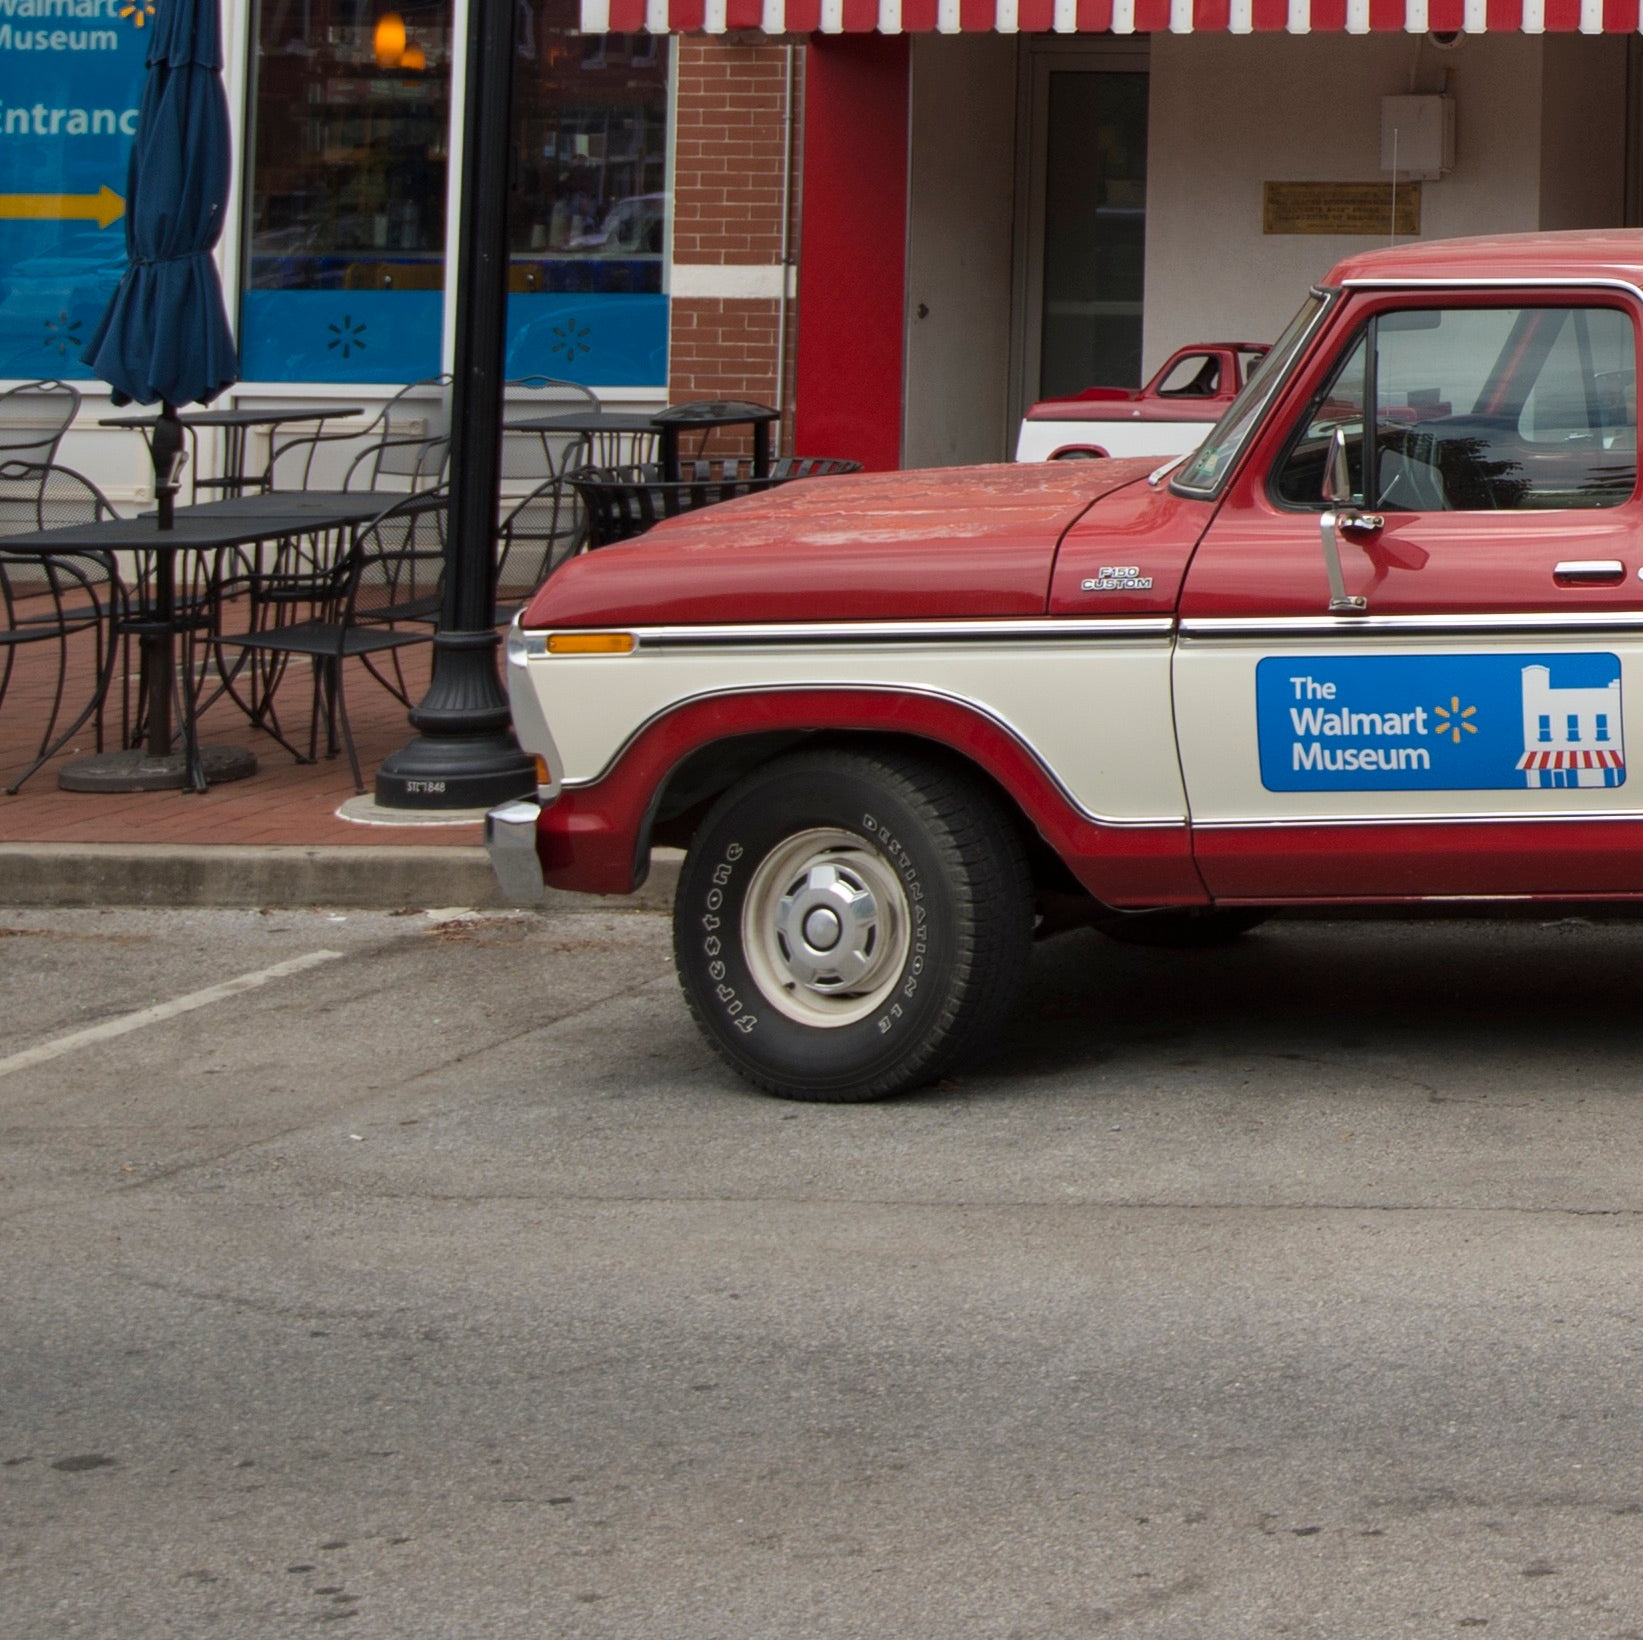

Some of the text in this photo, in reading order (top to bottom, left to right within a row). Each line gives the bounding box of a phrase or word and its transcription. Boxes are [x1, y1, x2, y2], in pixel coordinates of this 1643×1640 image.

[0, 103, 139, 135] ntranc
[1081, 577, 1153, 591] CUSTOM
[1099, 566, 1140, 579] F150
[1290, 676, 1337, 700] The
[1289, 706, 1428, 736] Walmart
[1293, 742, 1431, 771] Museum
[862, 813, 927, 998] DESTINATION
[703, 842, 758, 1034] Firestone
